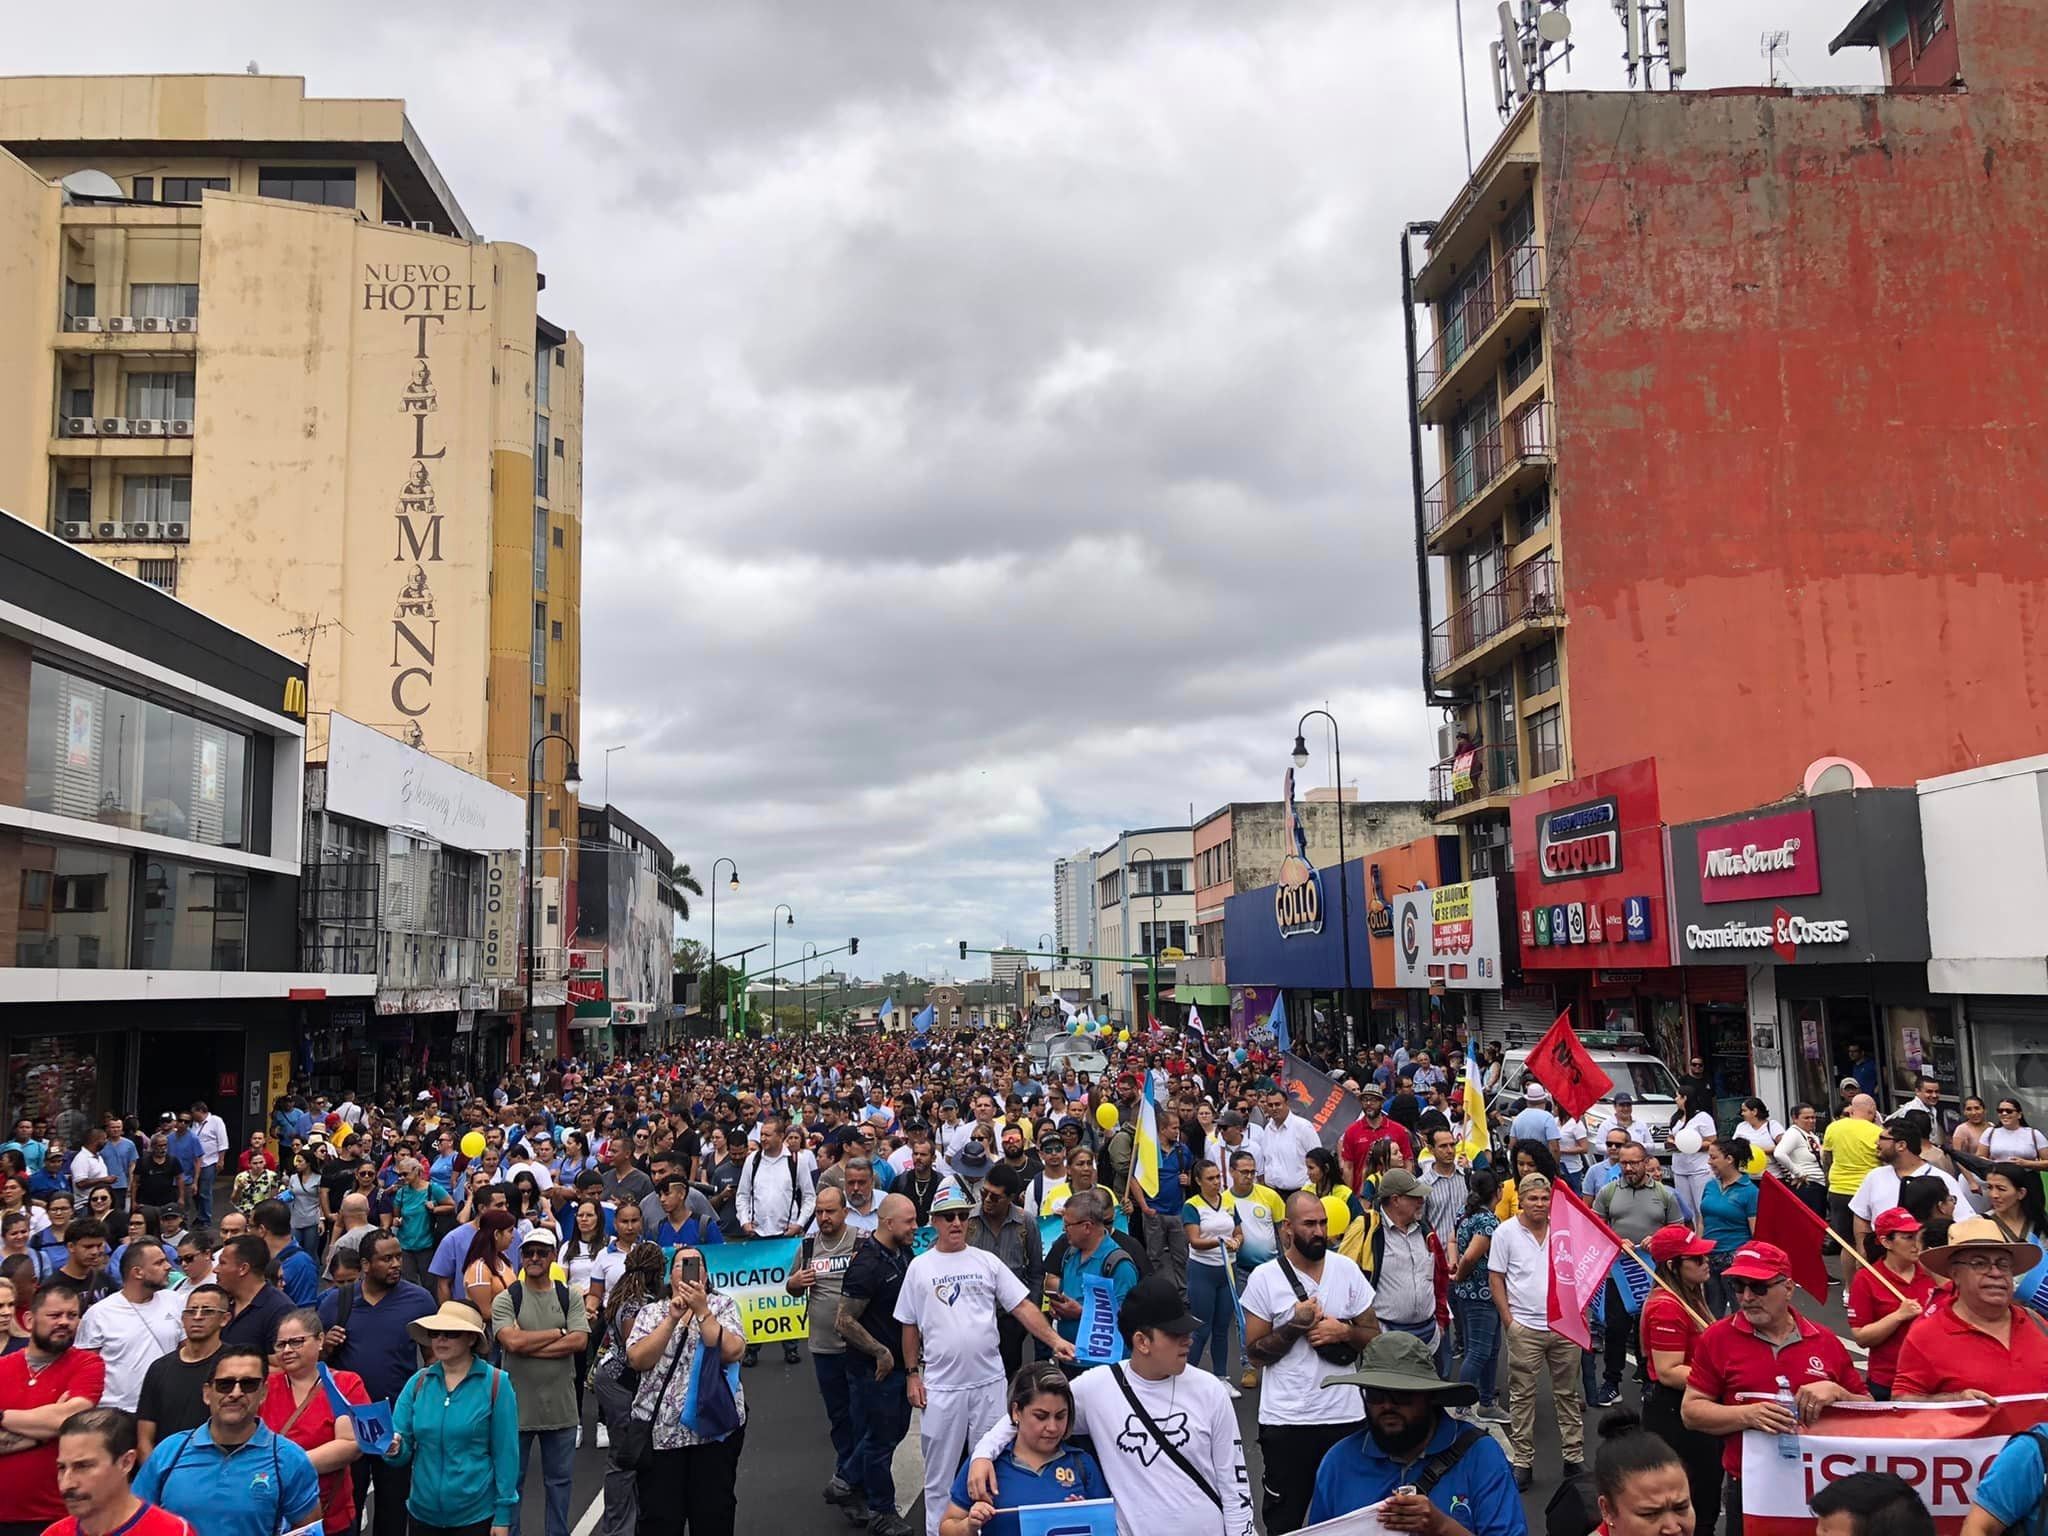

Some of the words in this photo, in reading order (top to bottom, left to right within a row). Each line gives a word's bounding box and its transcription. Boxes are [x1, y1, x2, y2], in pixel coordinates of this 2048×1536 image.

[365, 264, 450, 283] NUEVO
[363, 284, 487, 311] HOTEL
[1545, 835, 1611, 872] COQUI
[486, 853, 502, 912] TODO
[1276, 880, 1317, 927] GOLLO
[1686, 921, 1774, 949] Cosméticos
[1777, 918, 1790, 944] &
[1789, 916, 1849, 944] Cosas
[812, 1255, 851, 1272] TOMMY
[1619, 1257, 1651, 1306] UNDEC
[758, 1296, 777, 1310] EN
[752, 1316, 791, 1336] POR
[1088, 1287, 1114, 1358] UNDECA
[1055, 1467, 1075, 1482] 80
